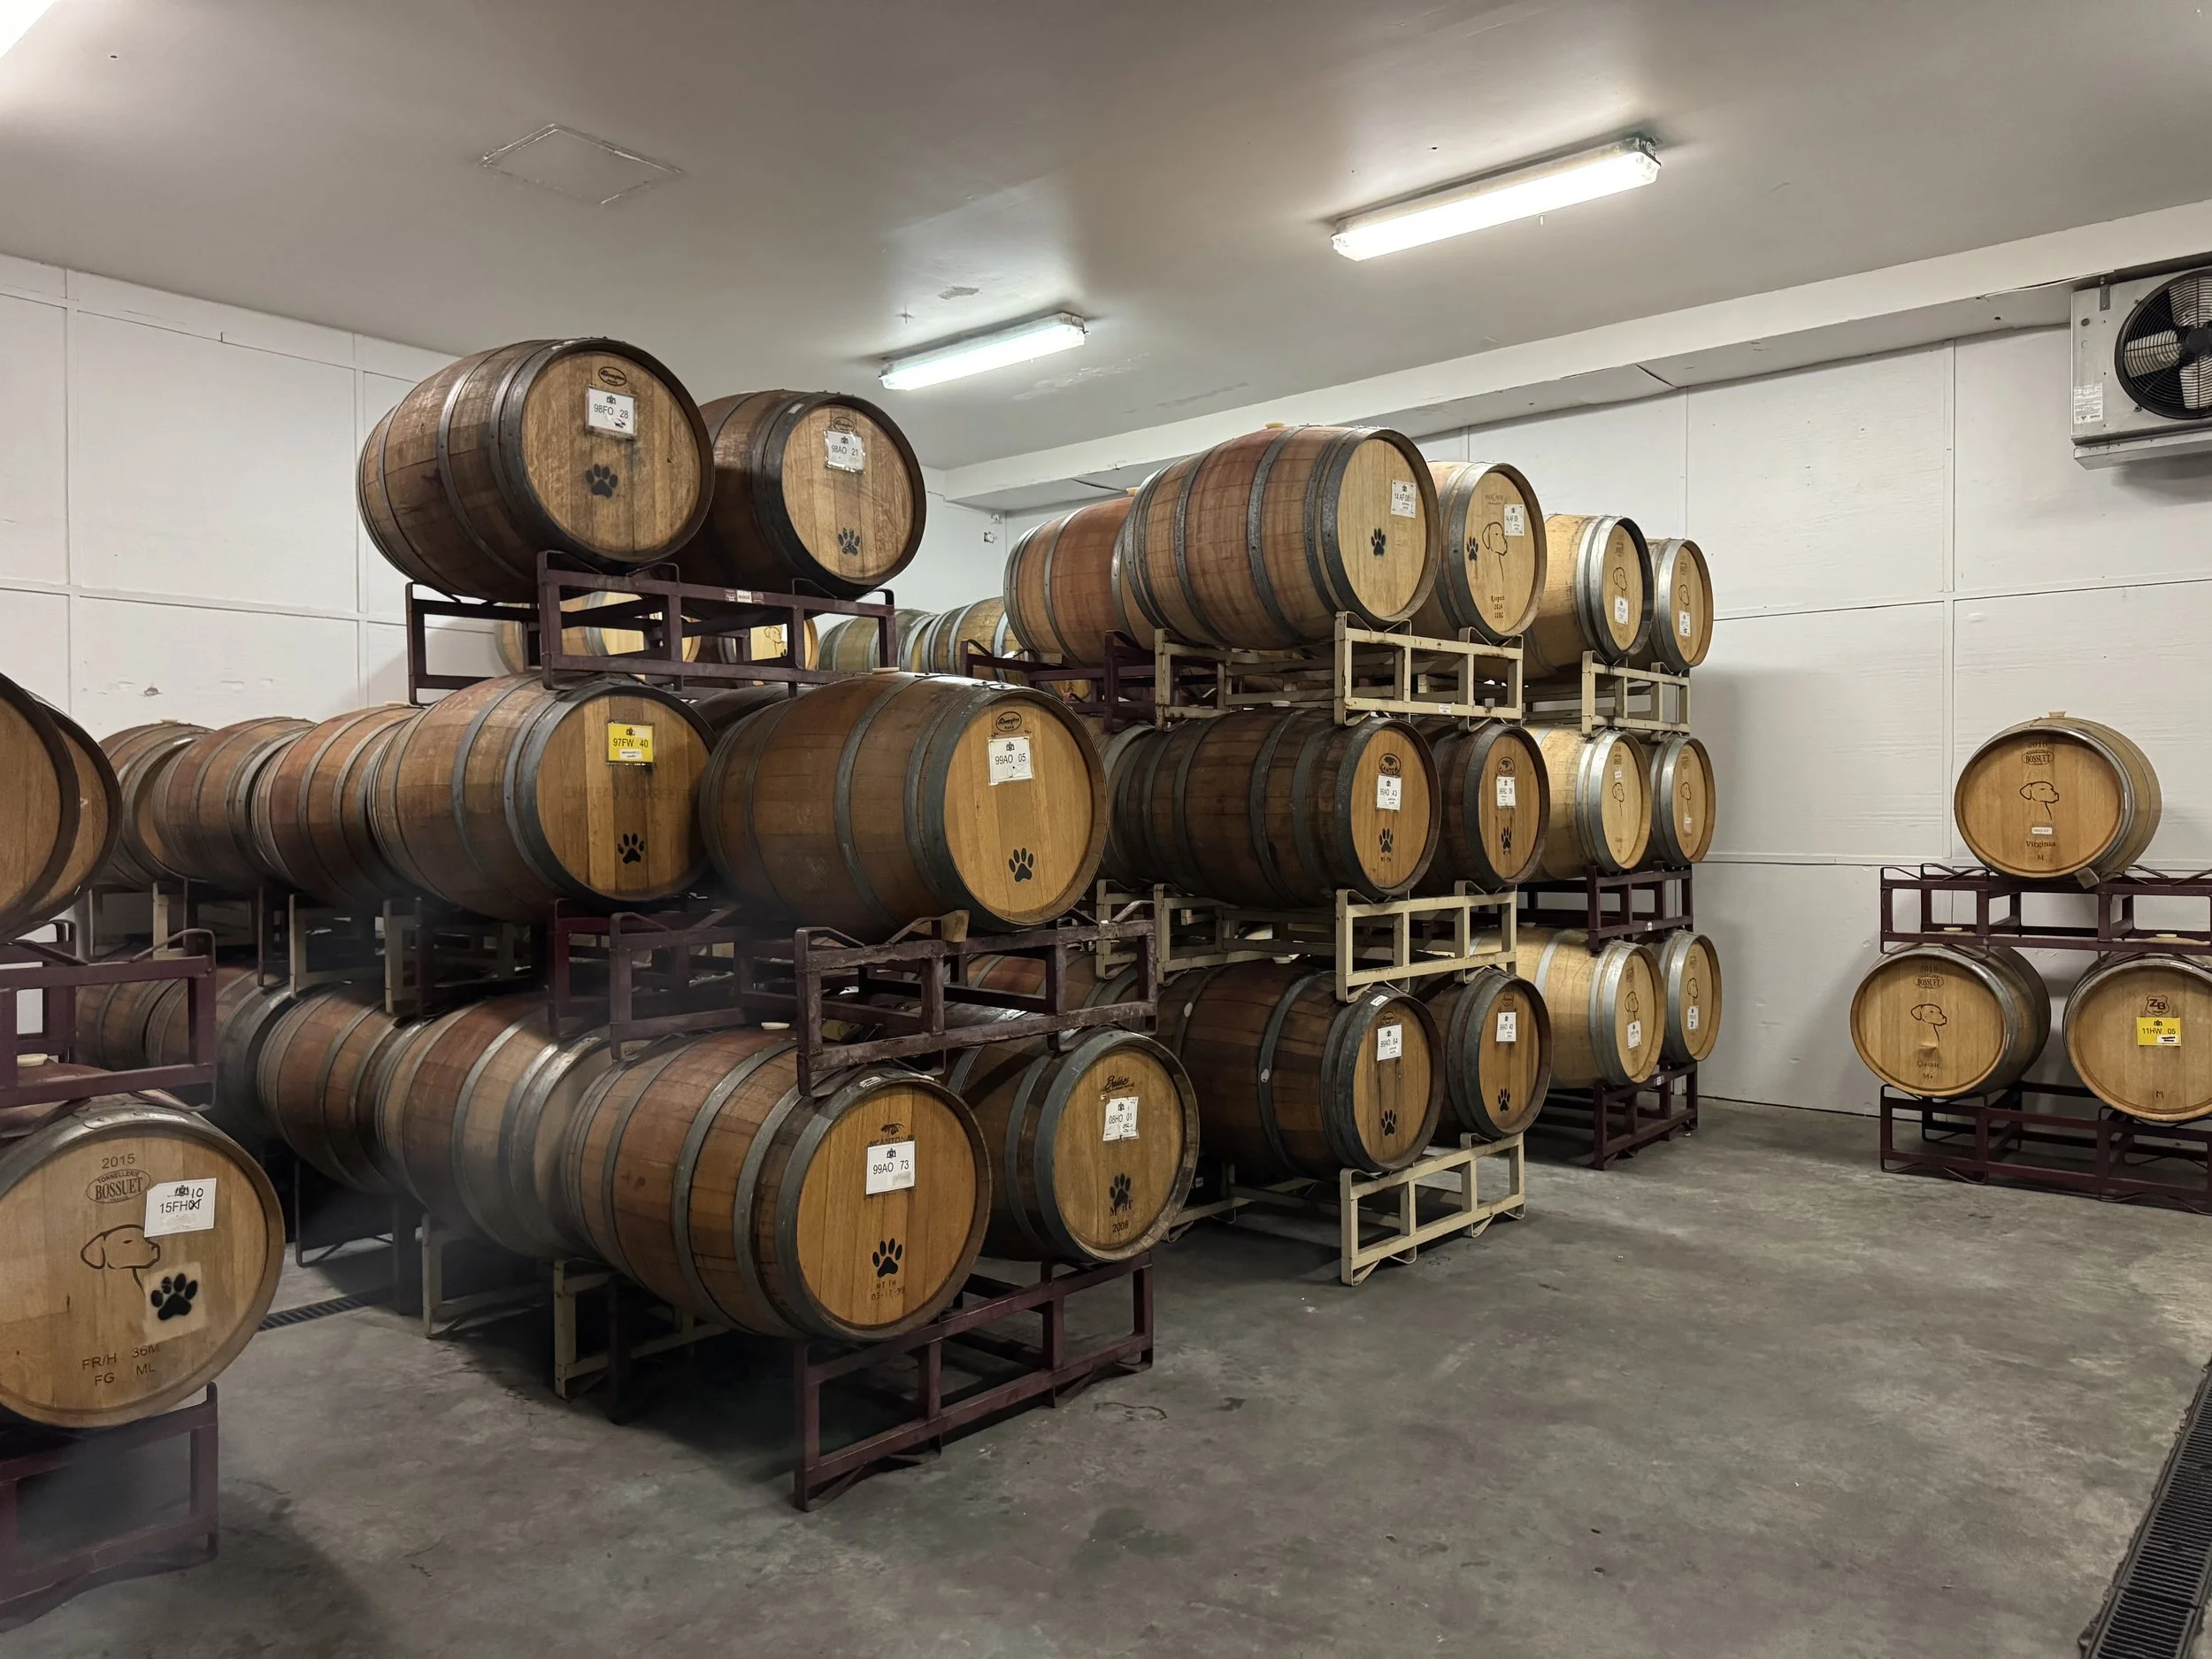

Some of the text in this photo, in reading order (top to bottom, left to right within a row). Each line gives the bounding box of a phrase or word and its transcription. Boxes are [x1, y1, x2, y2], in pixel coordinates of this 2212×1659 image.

[594, 403, 629, 419] 98FO 28
[831, 444, 858, 457] 98AO 21
[612, 737, 649, 749] 97FW 40
[995, 753, 1026, 765] 99AO 05
[2025, 840, 2055, 849] Virginia
[2149, 999, 2166, 1010] ZB
[2155, 1090, 2164, 1099] M
[101, 1153, 135, 1169] 2015
[872, 1159, 910, 1177] 99AO 73
[97, 1171, 141, 1184] TONNELLERIE
[95, 1177, 143, 1200] BOSSUET
[191, 1187, 204, 1199] 10
[81, 1344, 159, 1371] FR/H 36M
[95, 1363, 157, 1386] FG ML
